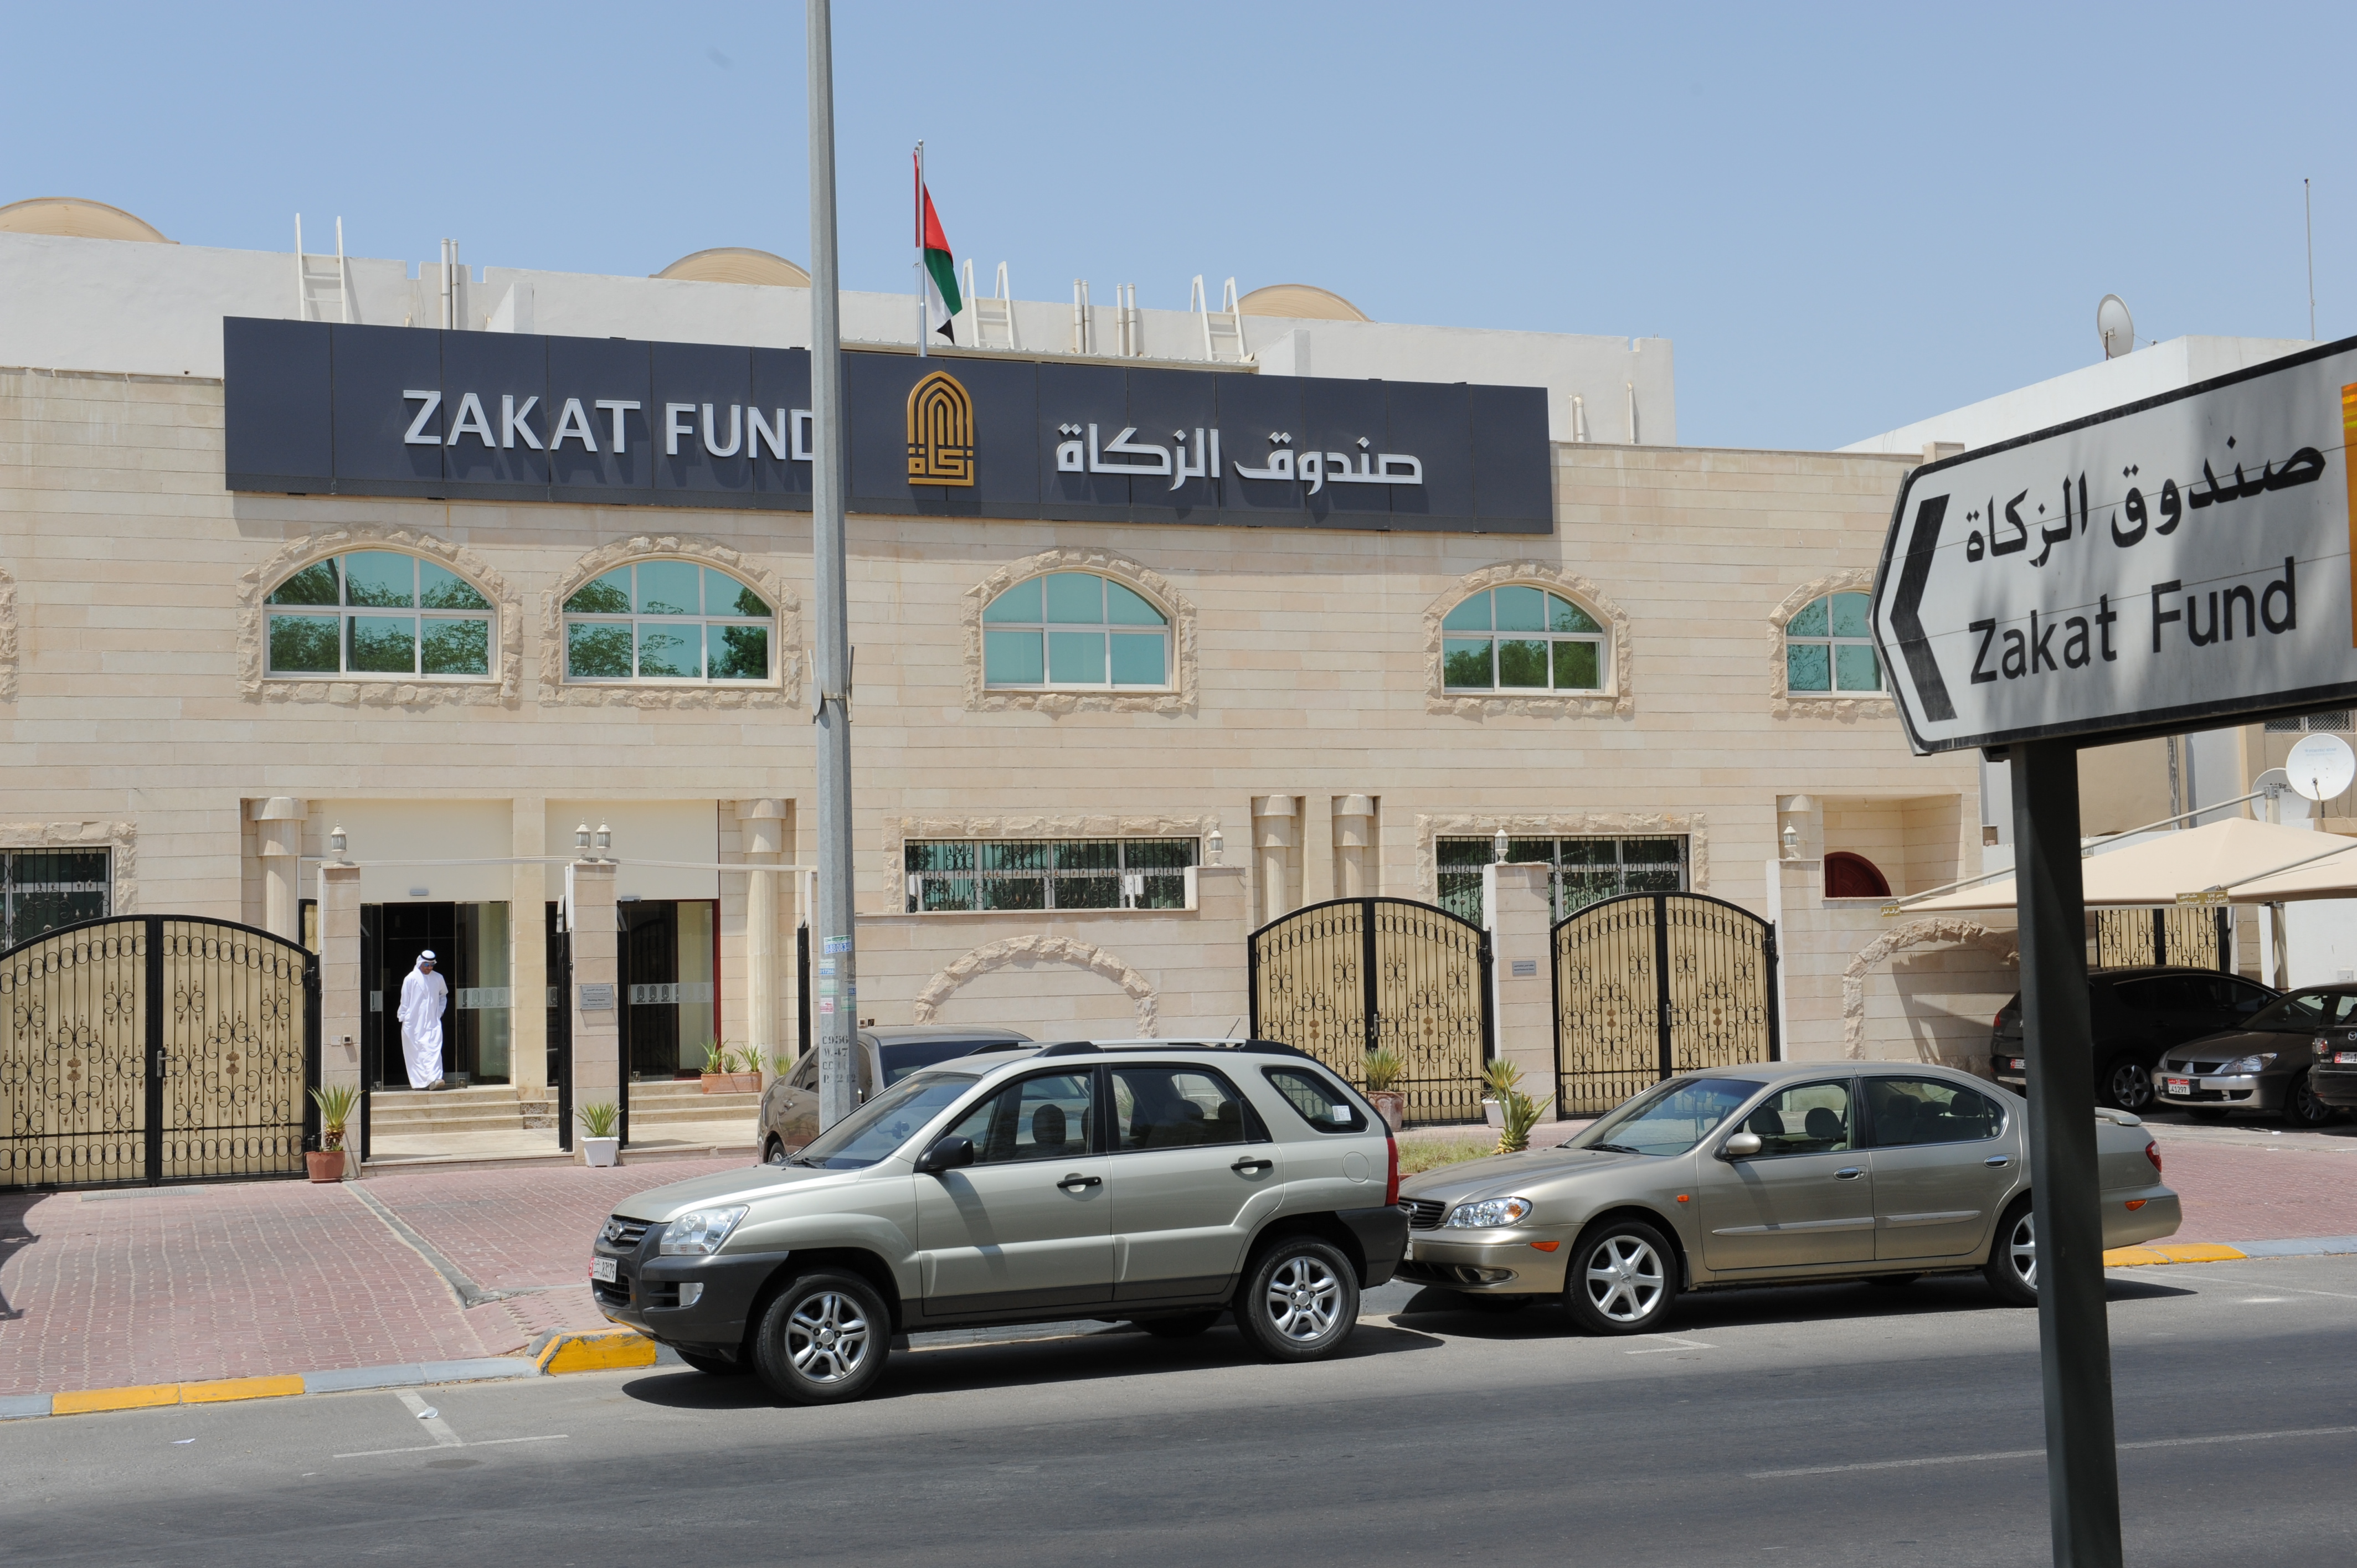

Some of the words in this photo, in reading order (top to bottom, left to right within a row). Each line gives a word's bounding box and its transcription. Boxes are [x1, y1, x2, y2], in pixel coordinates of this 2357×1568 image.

[403, 389, 641, 453] ZAKAT
[1057, 422, 1219, 491] الزكاة
[1233, 431, 1423, 496] صندوق
[2111, 435, 2325, 548] صندوق
[1966, 470, 2088, 568] الزكاة
[1969, 593, 2118, 685] Zakat
[2151, 555, 2298, 653] Fund
